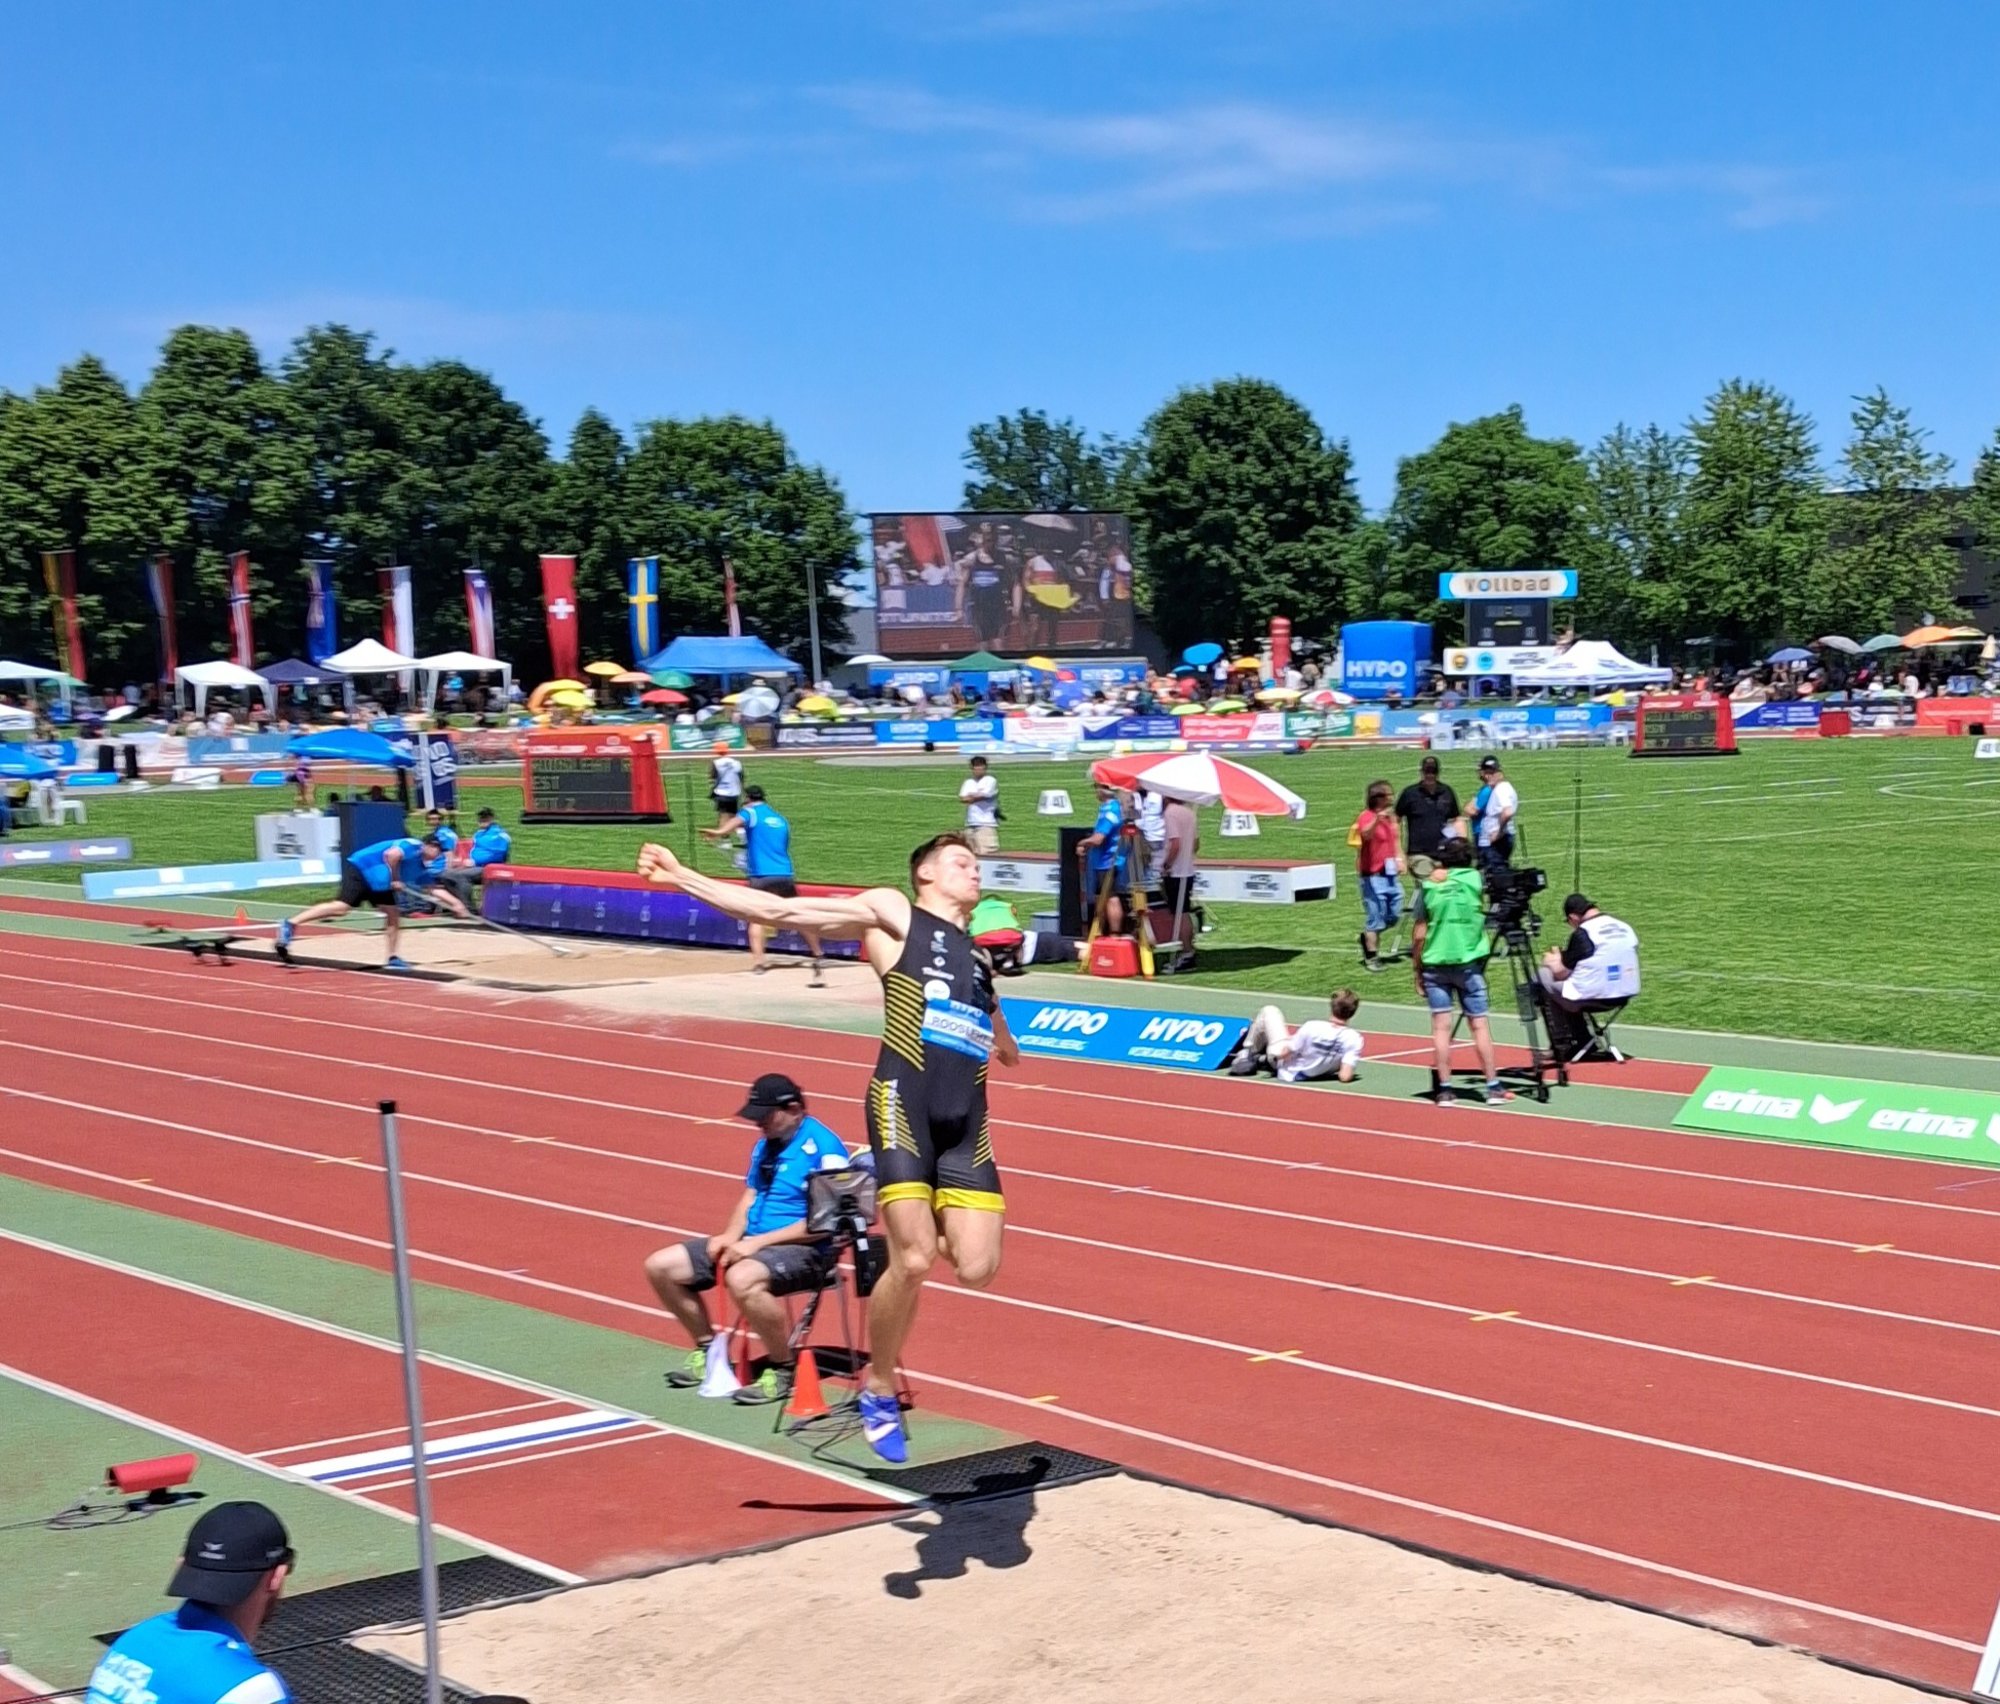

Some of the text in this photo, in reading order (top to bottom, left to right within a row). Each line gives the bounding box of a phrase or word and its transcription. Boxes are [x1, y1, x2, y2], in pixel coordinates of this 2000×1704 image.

[1464, 578, 1550, 592] Vollbad
[1346, 660, 1408, 678] HYPO
[688, 909, 699, 926] 7
[1028, 1006, 1109, 1036] HYPO
[1139, 1016, 1225, 1046] HYPO
[1702, 1088, 1804, 1119] erima
[1867, 1107, 1979, 1139] erima
